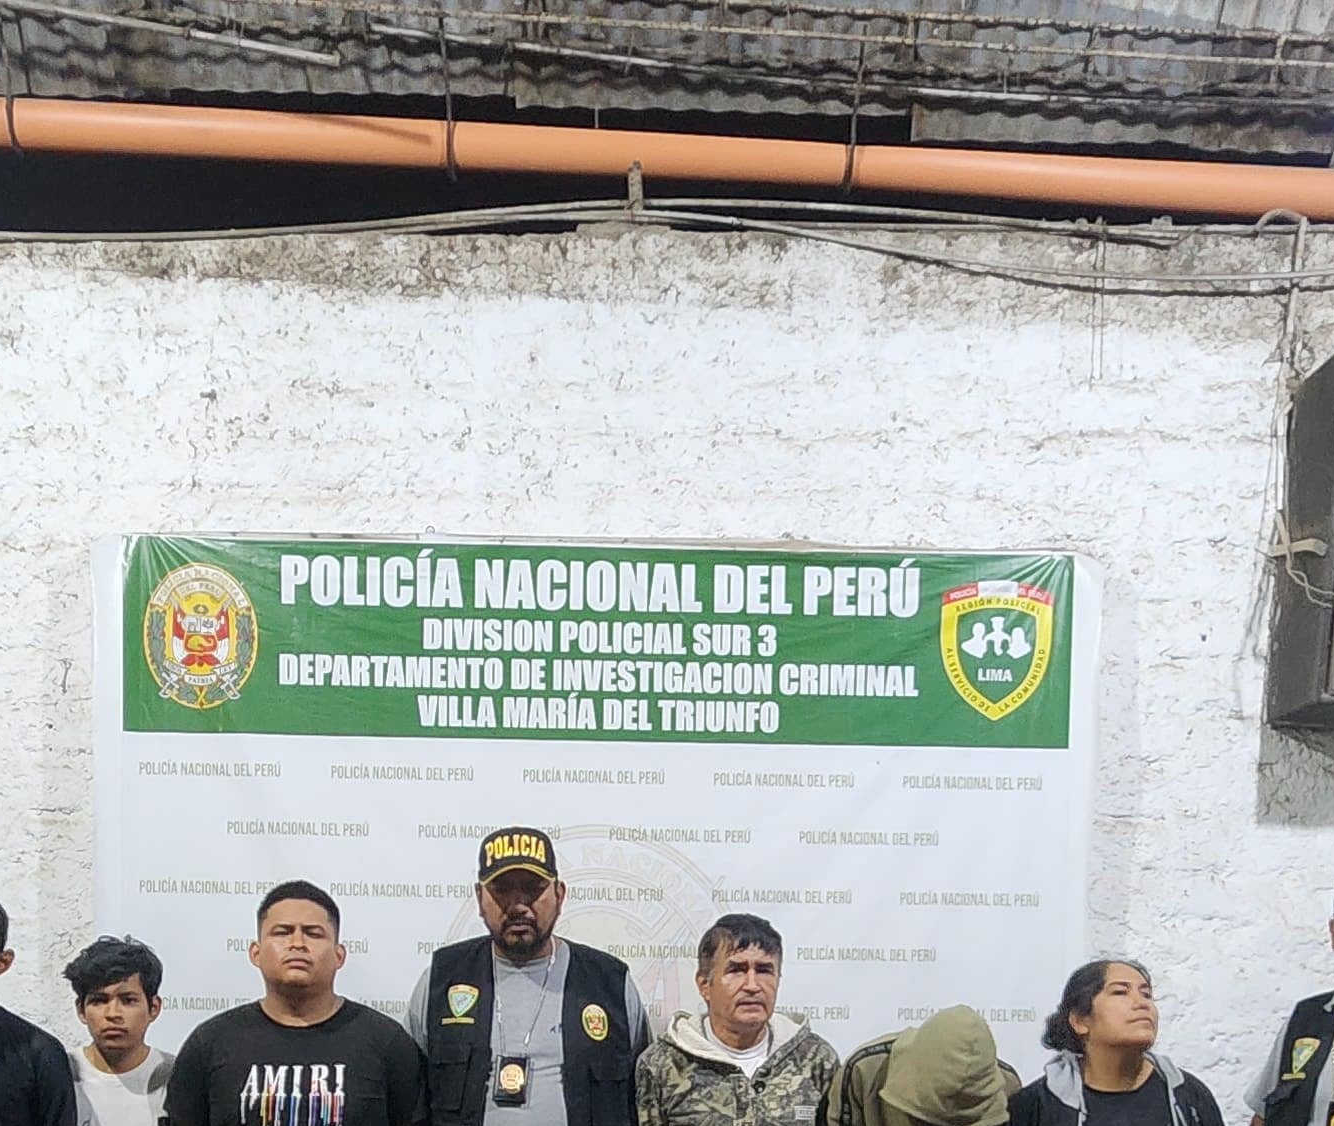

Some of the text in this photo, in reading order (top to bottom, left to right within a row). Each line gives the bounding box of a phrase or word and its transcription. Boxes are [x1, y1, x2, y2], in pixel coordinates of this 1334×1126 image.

[280, 548, 921, 618] POLICÍA NACIONAL DEL PERÚ
[423, 618, 777, 657] DIVISION POLICIAL SUR 3
[279, 653, 919, 697] DEPARTAMENTO DE INVESTIGACION CRIMINAL
[977, 667, 1013, 682] LIMA
[417, 691, 780, 734] VILLA MARÍA DEL TRIUNFO
[139, 760, 281, 777] POLICÍA NACIONAL DEL PERÚ
[331, 765, 473, 781] POLICÍA NACIONAL DEL PERÚ
[523, 769, 665, 784] POLICÍA NACIONAL DEL PERÚ
[714, 771, 854, 788] POLICÍA NACIONAL DEL PERÚ
[902, 776, 1042, 791] POLICÍA NACIONAL DEL PERÚ
[227, 819, 369, 837] POLICÍA NACIONAL DEL PERÚ
[419, 823, 457, 838] POLICÍA
[609, 825, 751, 843] POLICÍA NACIONAL DEL PERÚ
[799, 831, 939, 846] POLICÍA NACIONAL DEL PERÚ
[484, 833, 547, 868] POLICIA
[140, 877, 177, 893] POLICÍA
[181, 880, 232, 894] NACIONAL
[235, 881, 254, 895] DEL
[330, 882, 472, 899] POLICÍA NACIONAL DEL PERÚ
[616, 888, 635, 901] DEL
[638, 886, 664, 902] PERÚ
[713, 887, 852, 904] POLICÍA NACIONAL DEL PERÚ
[900, 892, 1039, 907] POLICÍA NACIONAL DEL PERÚ
[797, 947, 936, 962] POLICÍA NACIONAL DEL PERÚ
[824, 1003, 850, 1020] PERÚ
[990, 1008, 1008, 1022] DEL
[1011, 1006, 1036, 1023] PERÚ
